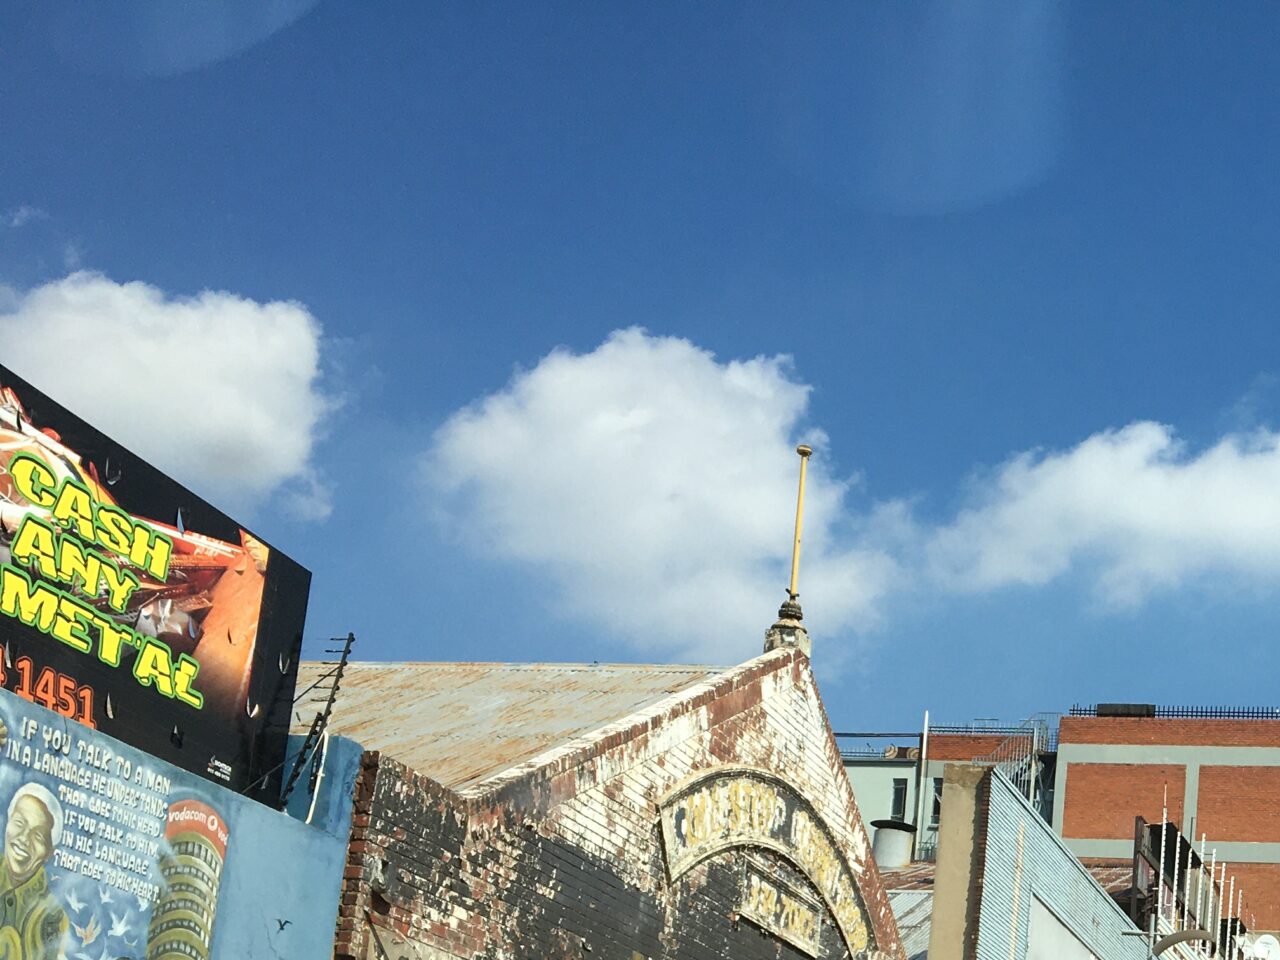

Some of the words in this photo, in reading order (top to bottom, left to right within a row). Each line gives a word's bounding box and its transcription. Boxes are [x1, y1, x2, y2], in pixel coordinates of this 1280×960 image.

[8, 451, 173, 583] CASH
[11, 511, 140, 613] ANY
[14, 655, 97, 729] 1451
[6, 738, 20, 761] IN
[33, 748, 92, 789] LANGUAGE
[92, 774, 107, 796] HE
[21, 716, 38, 740] IF
[42, 725, 72, 755] YOU
[77, 740, 112, 773] TALK
[115, 755, 132, 780] TO
[134, 766, 143, 786] A
[145, 770, 171, 796] MAN
[58, 784, 87, 809] THAT
[64, 809, 78, 827] IF
[168, 806, 207, 823] vodacom
[62, 830, 74, 848] IN
